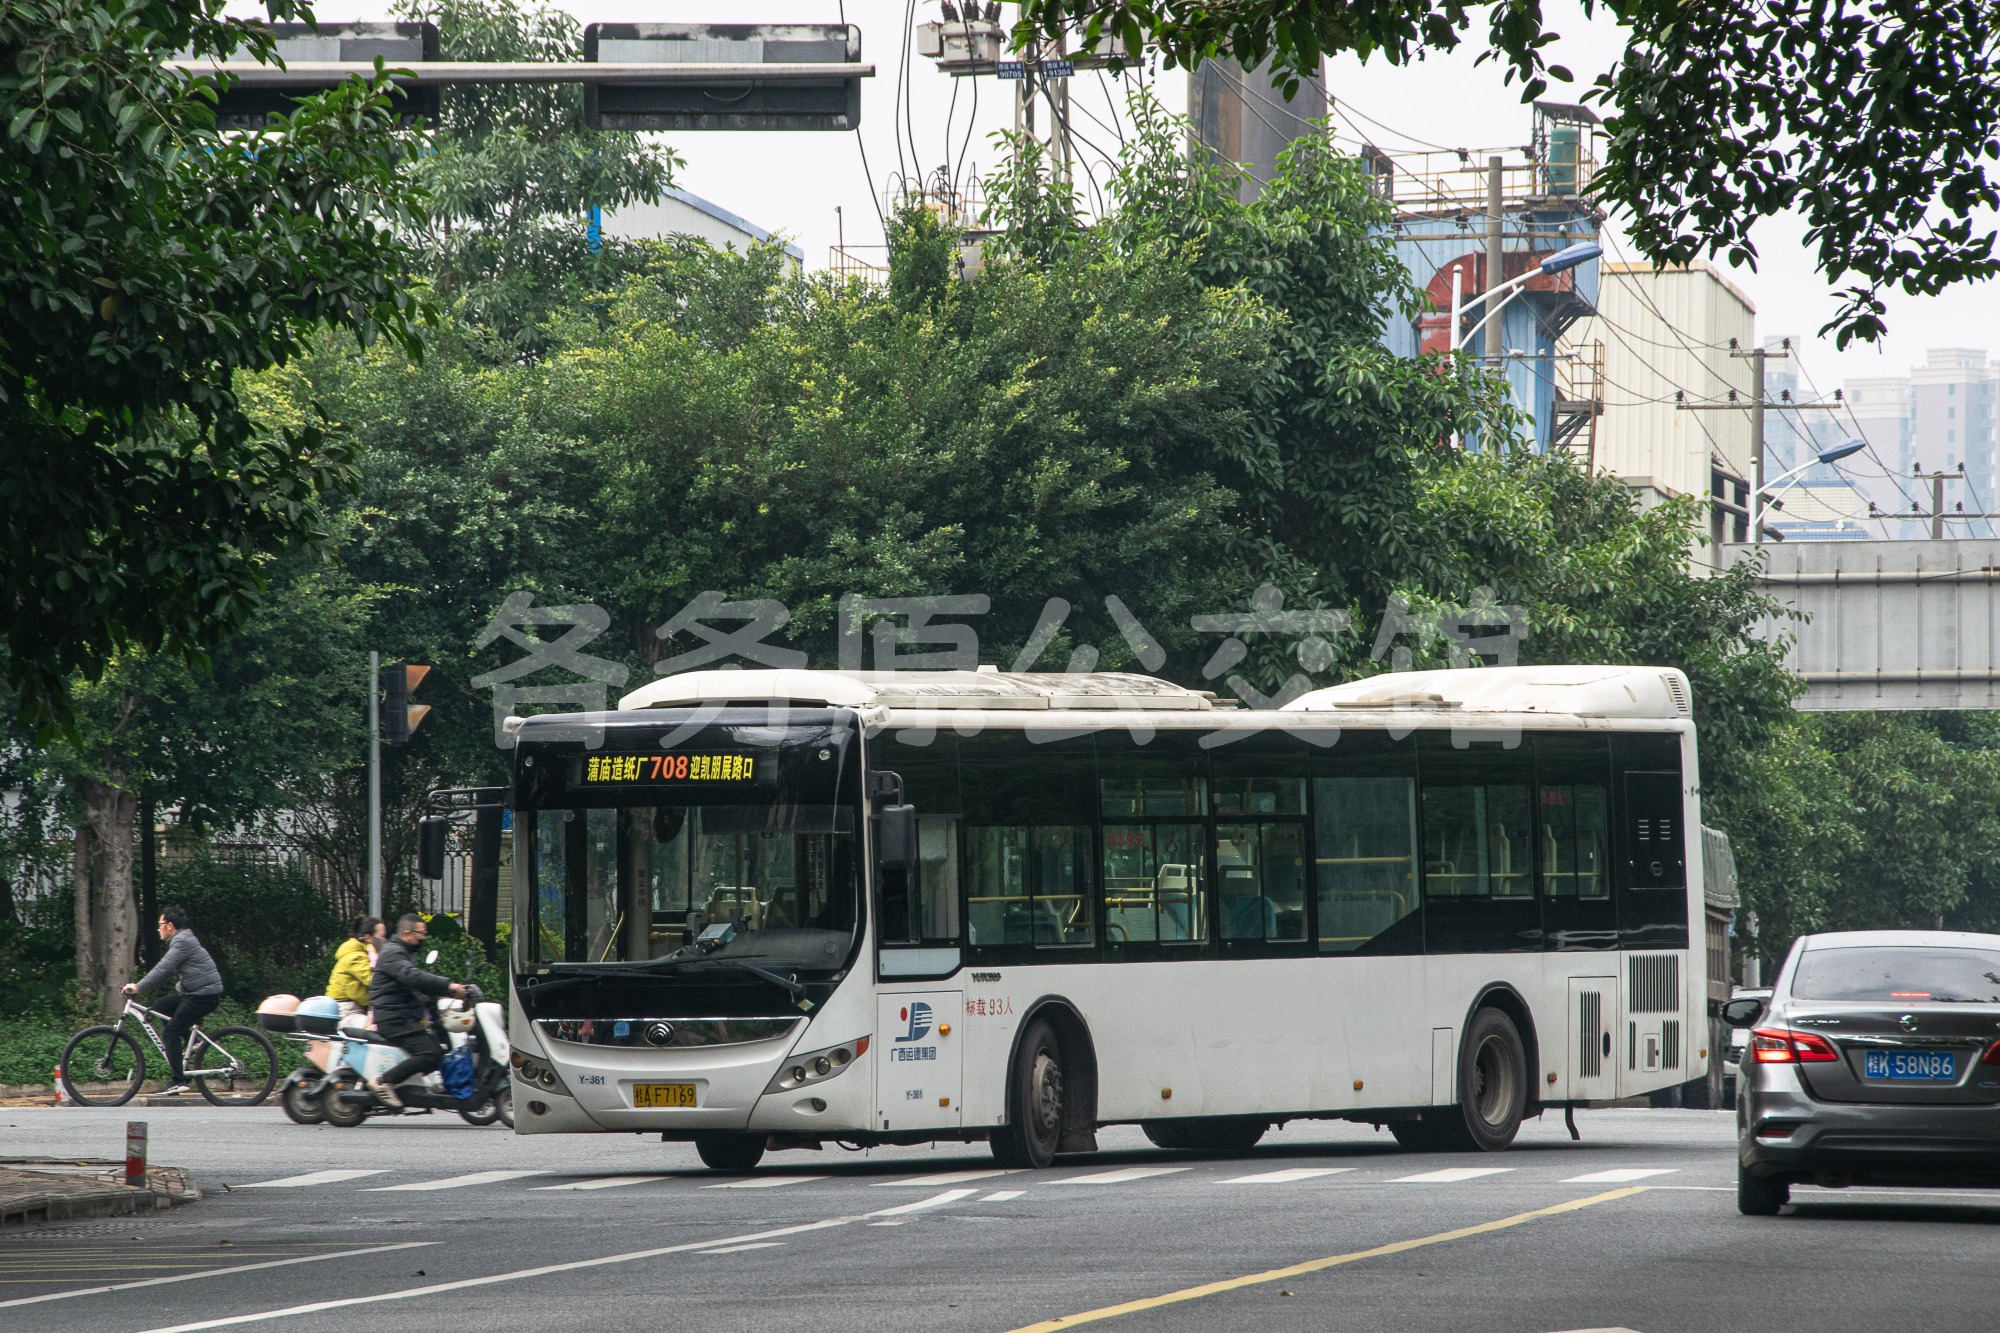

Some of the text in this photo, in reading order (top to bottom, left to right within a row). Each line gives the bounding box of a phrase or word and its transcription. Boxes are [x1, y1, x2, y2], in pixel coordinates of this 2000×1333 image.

[999, 70, 1022, 78] 90705
[1048, 68, 1071, 77] 91304
[587, 755, 753, 782] 蒲庙造纸厂 708 迎凯朋展路口
[890, 1046, 937, 1062] 广西运德集团
[579, 1075, 605, 1085] Y-361
[905, 1089, 923, 1100] Y-361
